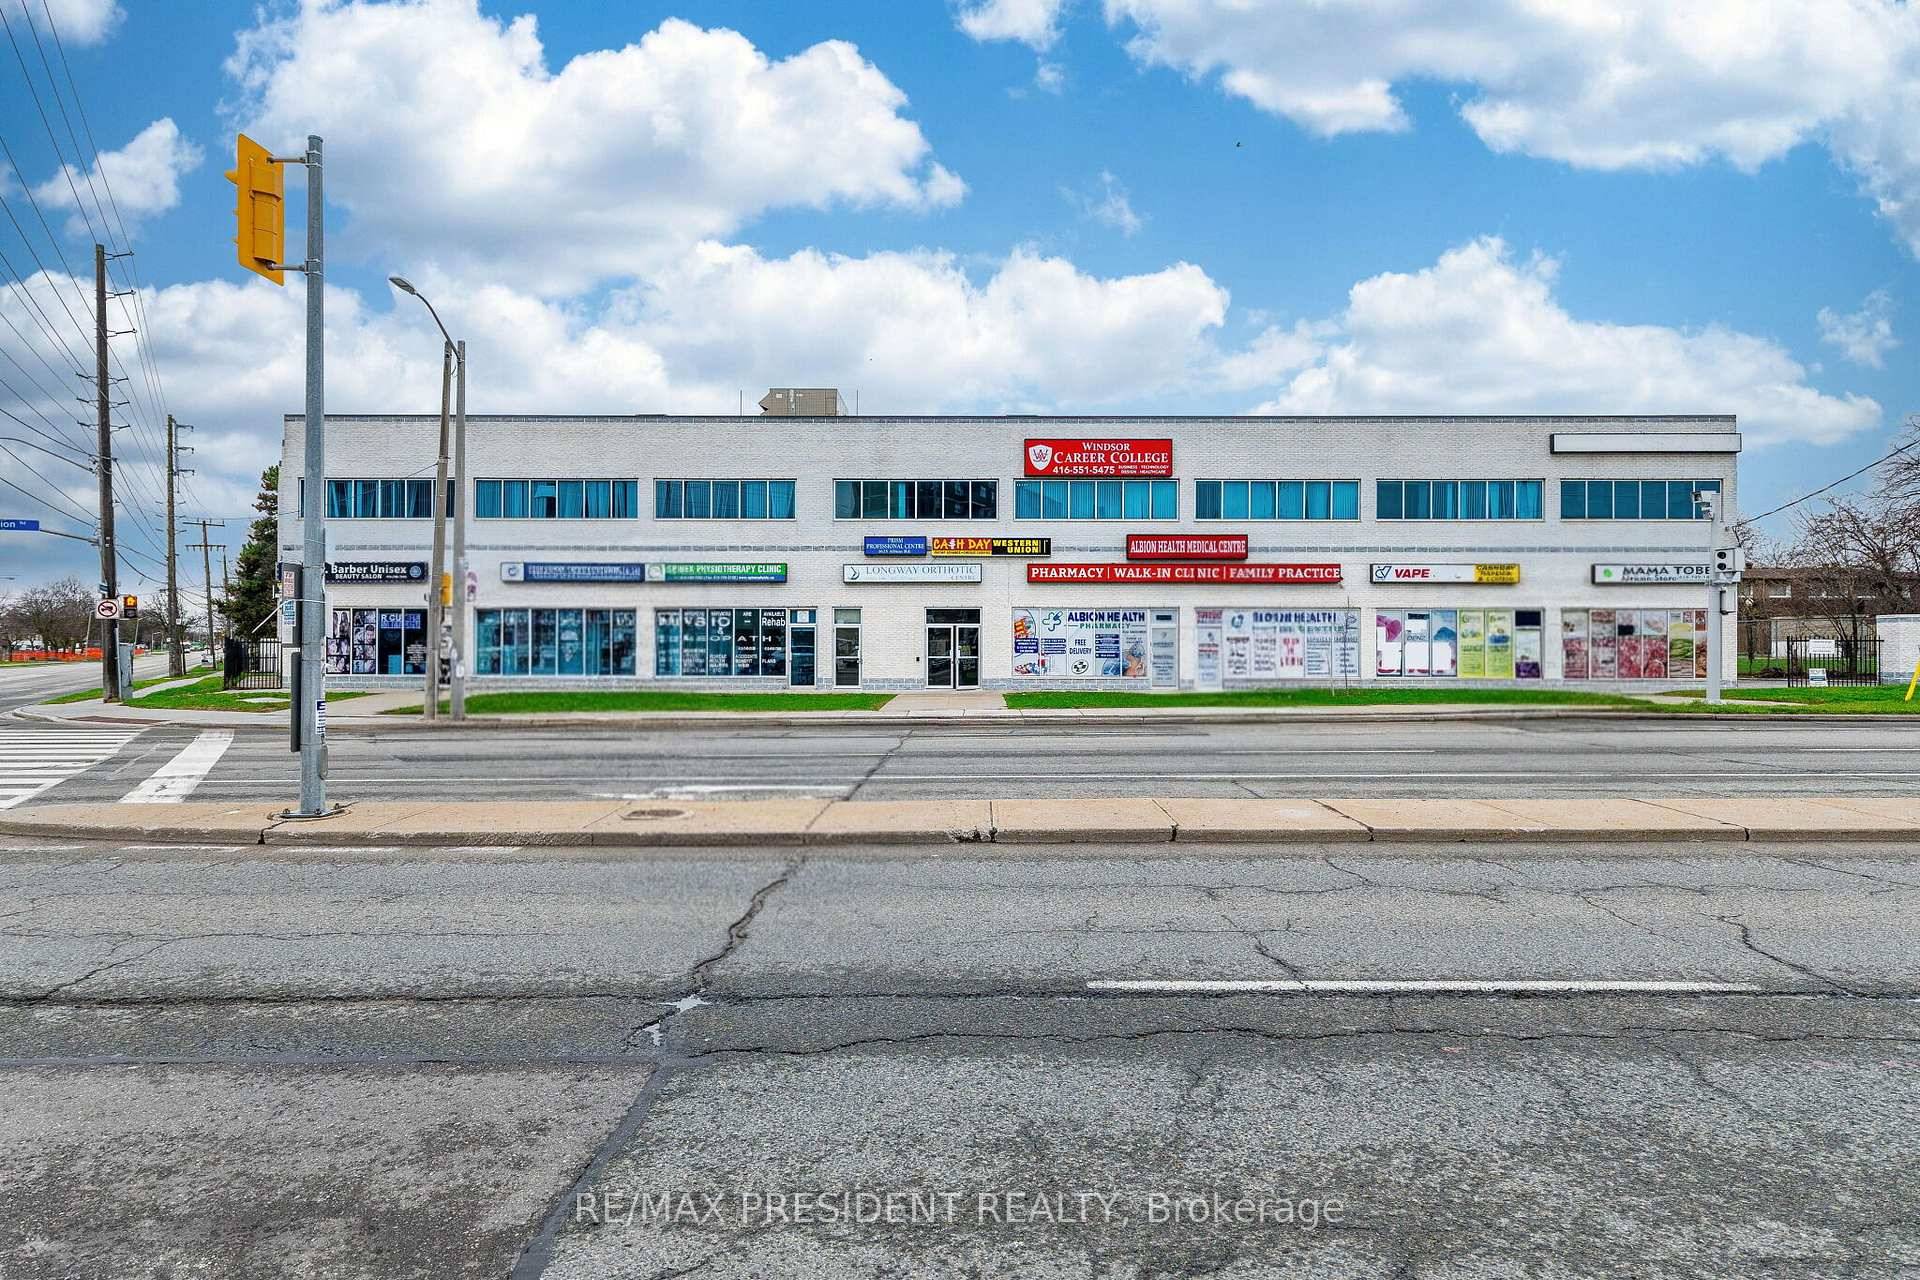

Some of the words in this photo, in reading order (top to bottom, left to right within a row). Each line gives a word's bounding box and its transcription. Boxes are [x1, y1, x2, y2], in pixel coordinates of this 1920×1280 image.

[1082, 442, 1130, 451] WINDSOR
[1054, 452, 1105, 463] CAREER
[1110, 452, 1168, 463] COLLEGE
[1052, 466, 1115, 474] 416-551-5475
[968, 538, 991, 549] DAY
[1131, 540, 1157, 552] ALBION
[1158, 540, 1185, 552] HEALTH
[1187, 540, 1218, 552] MEDICAL
[1218, 540, 1245, 552] CENTRE
[331, 564, 368, 574] Barber
[370, 564, 407, 574] Unisex
[696, 564, 756, 573] PHYSIOTHERAPY
[758, 564, 781, 573] CLINIC
[866, 566, 919, 574] LONGWAY
[922, 566, 976, 574] ORTHOTIC
[1031, 567, 1104, 578] PHARMACY
[1114, 567, 1171, 578] WALK-IN
[1175, 567, 1220, 578] CLINIC
[1230, 567, 1274, 578] FAMILY
[1279, 567, 1340, 578] PRACTICE
[1394, 568, 1430, 578] VAPE
[1622, 566, 1666, 575] MAMA
[761, 617, 786, 627] Rehab
[1068, 612, 1105, 622] ALBION
[1107, 612, 1145, 622] HEALTH
